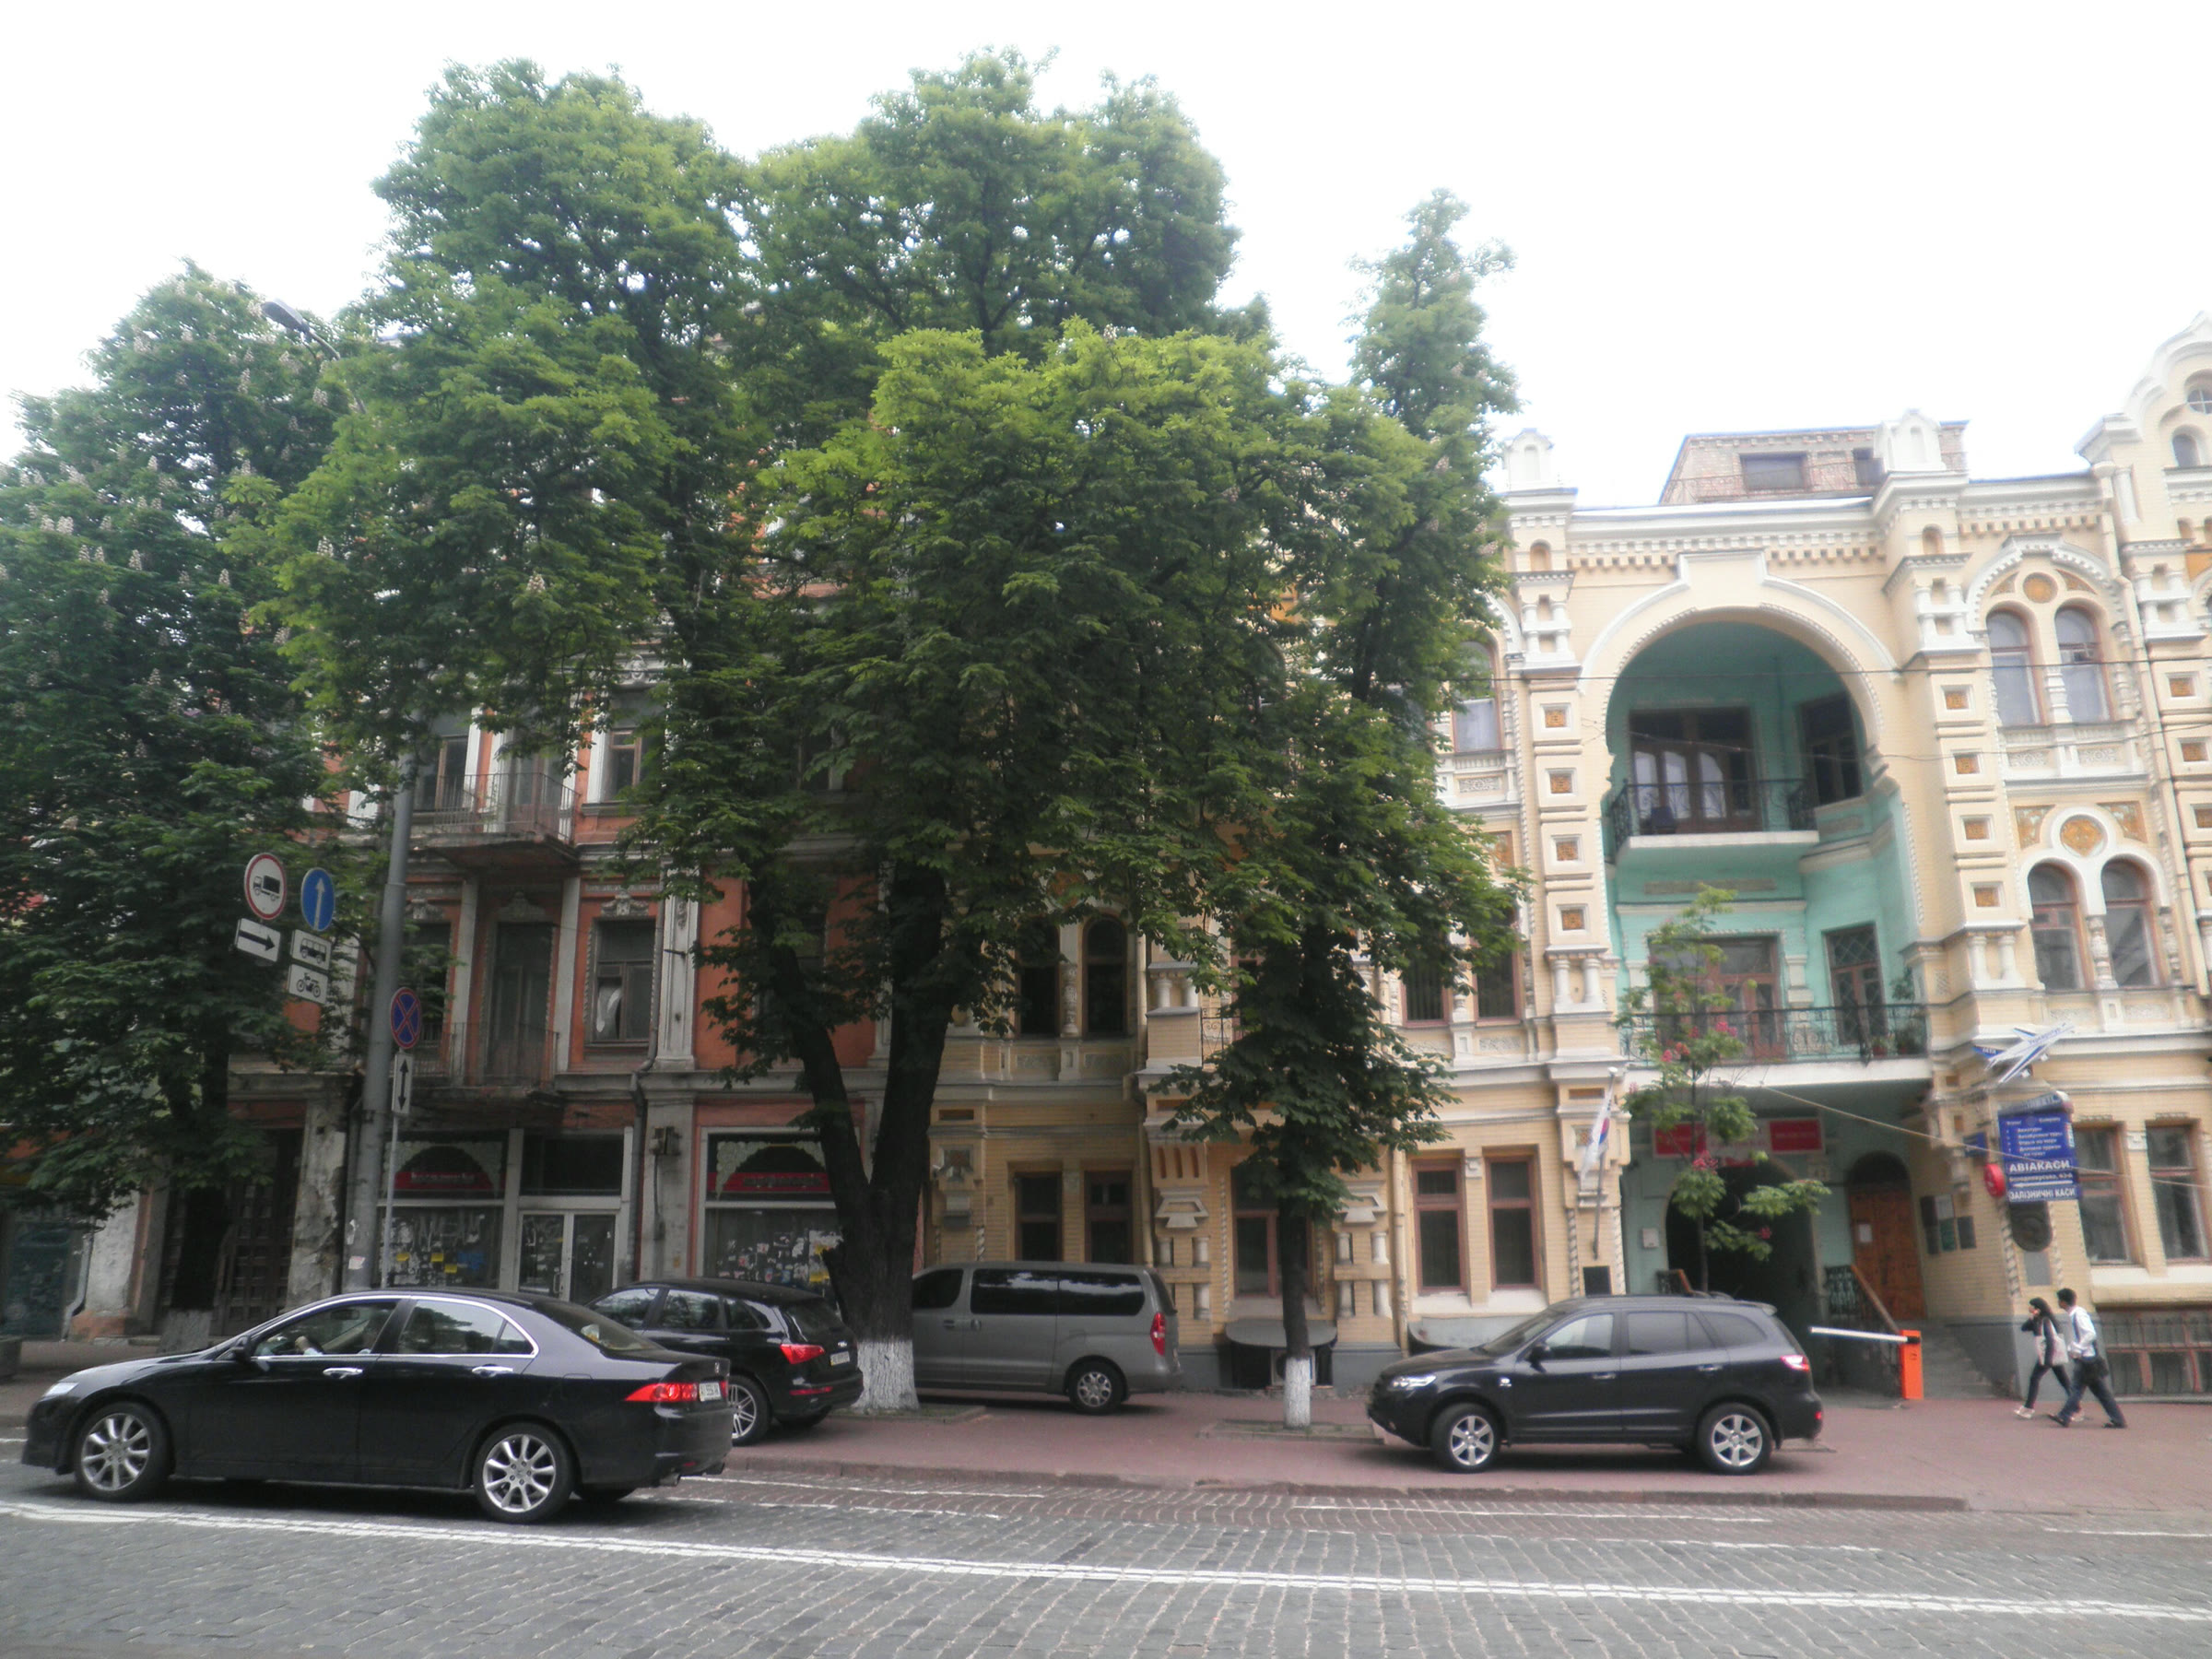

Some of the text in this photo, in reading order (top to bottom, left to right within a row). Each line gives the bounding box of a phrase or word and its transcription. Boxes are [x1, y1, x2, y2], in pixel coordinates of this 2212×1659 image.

[2009, 1160, 2071, 1172] АВІАКАСИ
[2010, 1187, 2076, 1200] ЗАЛІЗНИЧНІ КАСИ
